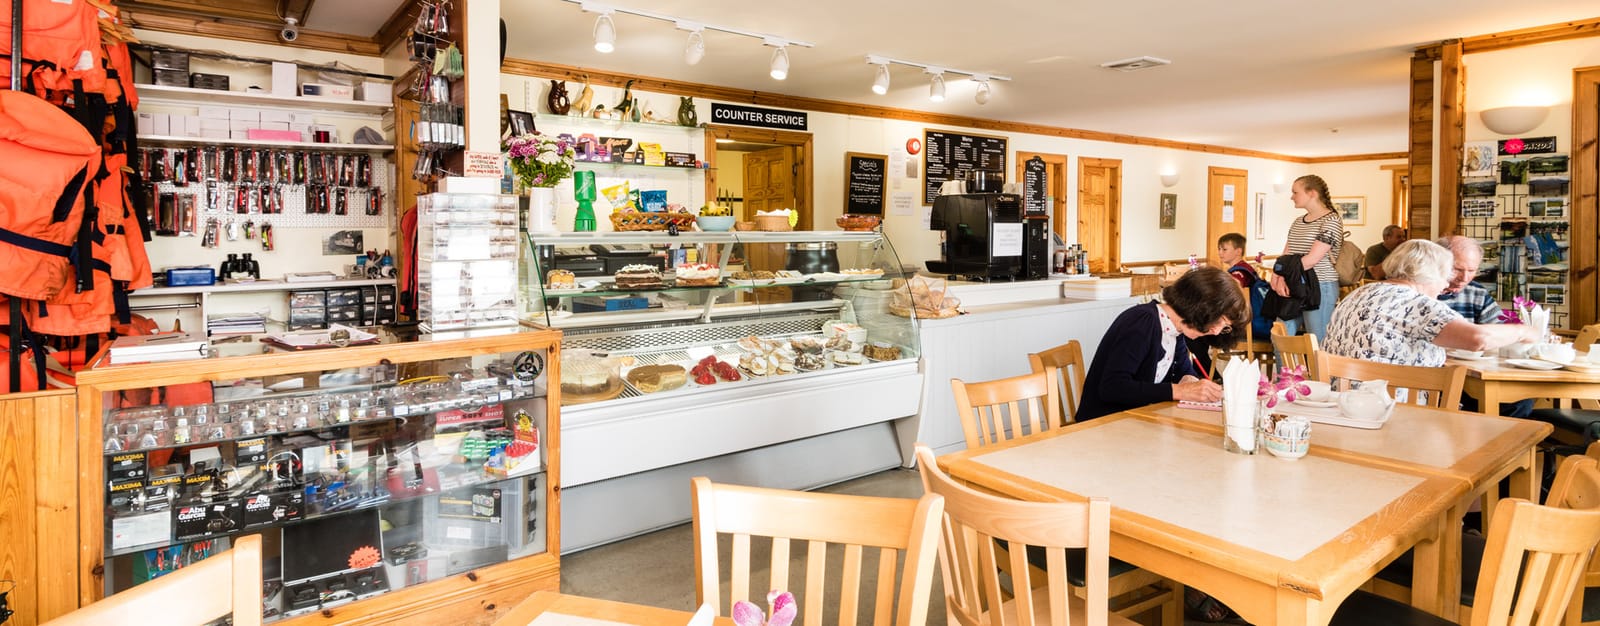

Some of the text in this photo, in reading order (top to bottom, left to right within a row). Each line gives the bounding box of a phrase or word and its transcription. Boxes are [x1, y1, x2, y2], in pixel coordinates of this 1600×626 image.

[715, 108, 805, 126] COUNTER SERVICE
[238, 439, 266, 448] MAXIMA
[113, 453, 145, 462] MAXIMA
[186, 475, 211, 484] MAXIM
[111, 481, 142, 491] MAXIMA
[189, 506, 206, 514] Abu
[246, 501, 271, 510] Garcia
[178, 511, 206, 520] Garcia
